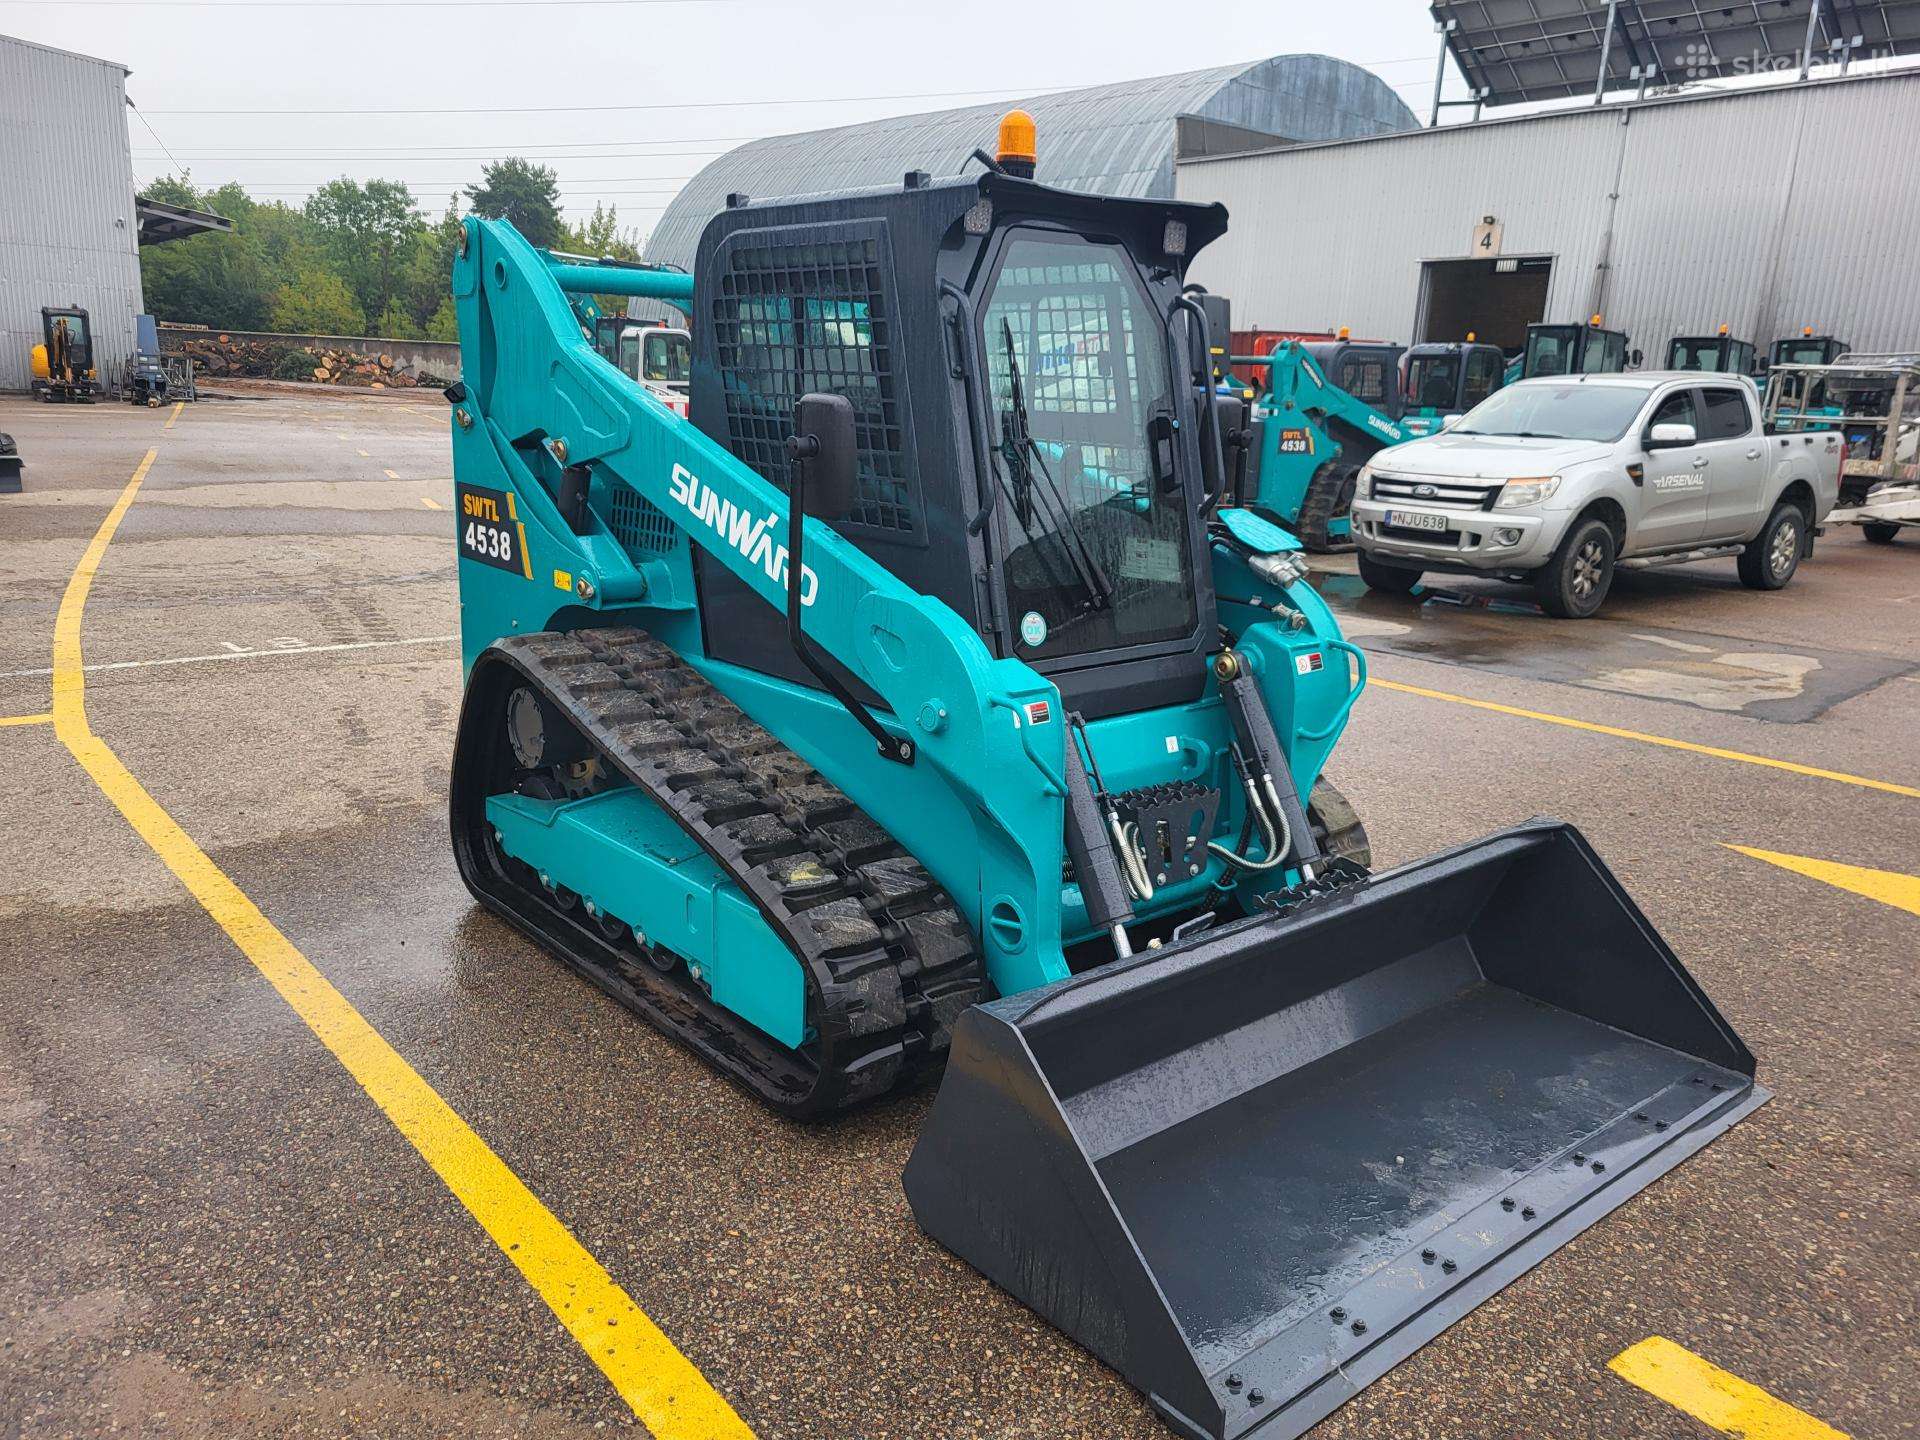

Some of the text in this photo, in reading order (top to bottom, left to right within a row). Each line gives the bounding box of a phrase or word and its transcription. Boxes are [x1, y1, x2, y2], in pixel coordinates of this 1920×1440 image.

[1480, 232, 1491, 250] 4
[1281, 440, 1307, 452] 4538
[463, 493, 500, 522] SWTL
[465, 521, 512, 561] 4538
